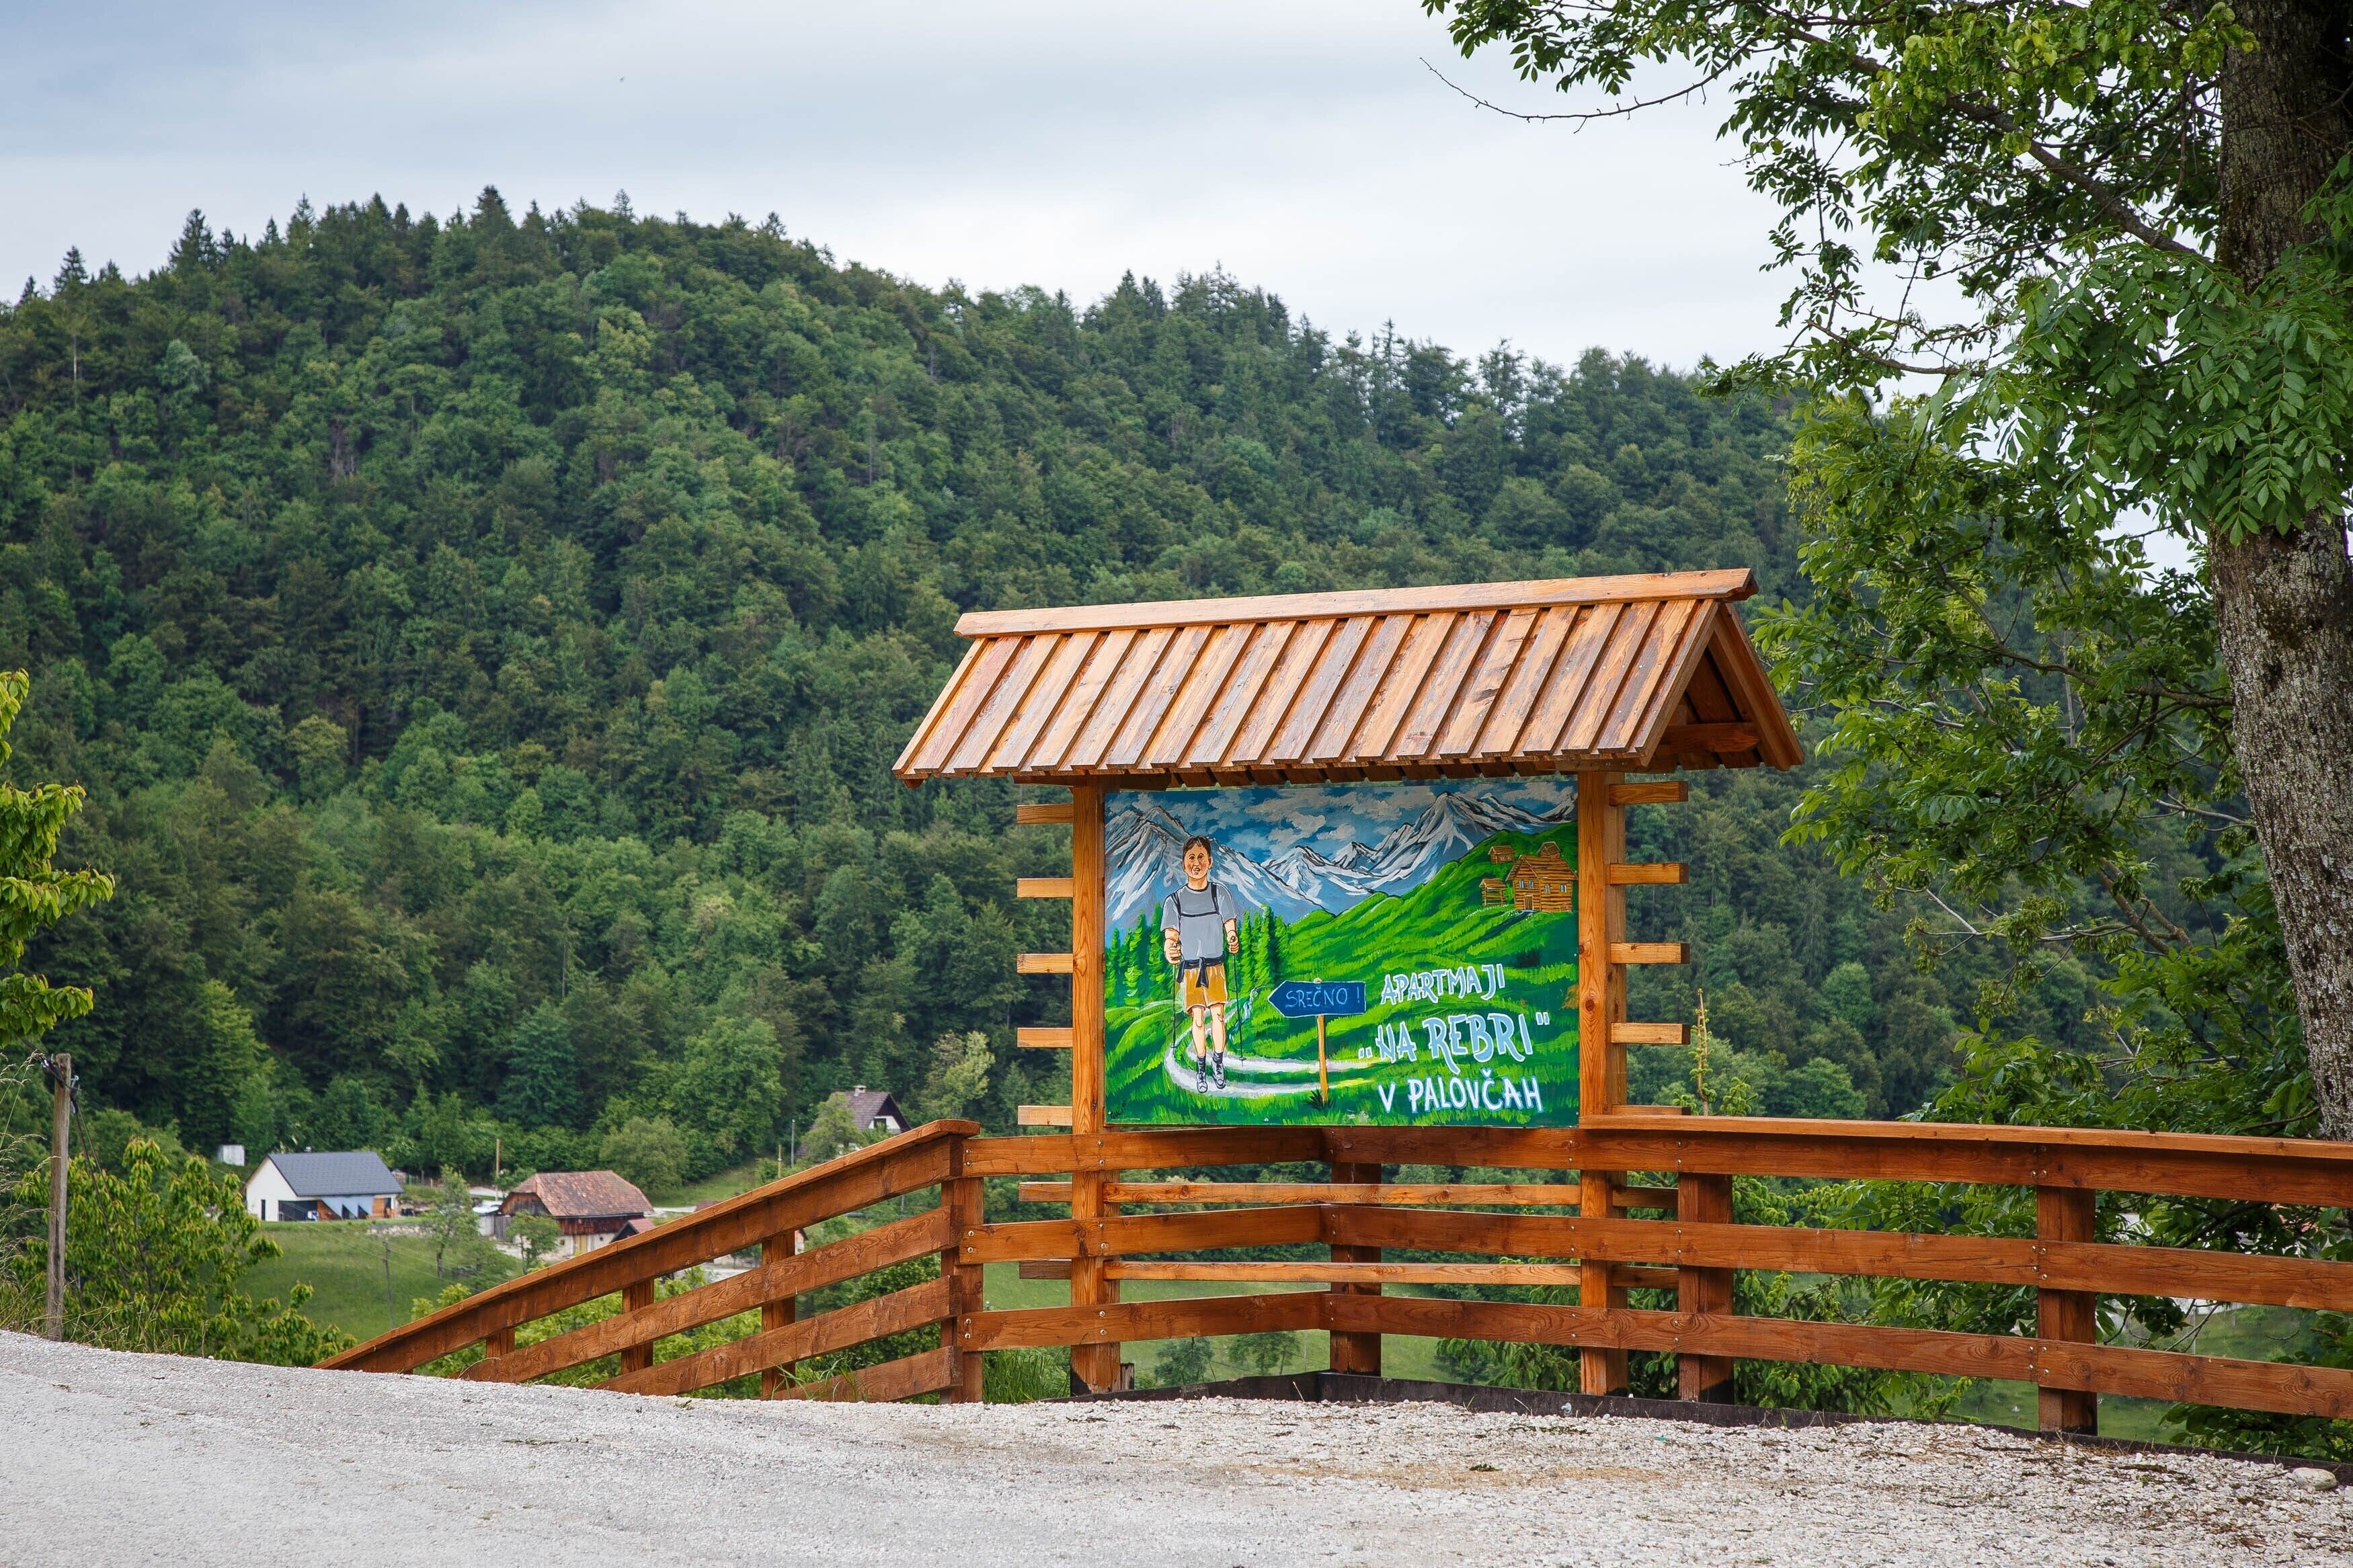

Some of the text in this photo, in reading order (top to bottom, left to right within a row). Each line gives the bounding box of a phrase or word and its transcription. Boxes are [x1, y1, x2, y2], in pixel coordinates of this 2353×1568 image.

[1285, 986, 1348, 1008] SREČNO
[1380, 964, 1505, 1005] APARTMAJI
[1378, 1067, 1544, 1114] V PALOVČAH
